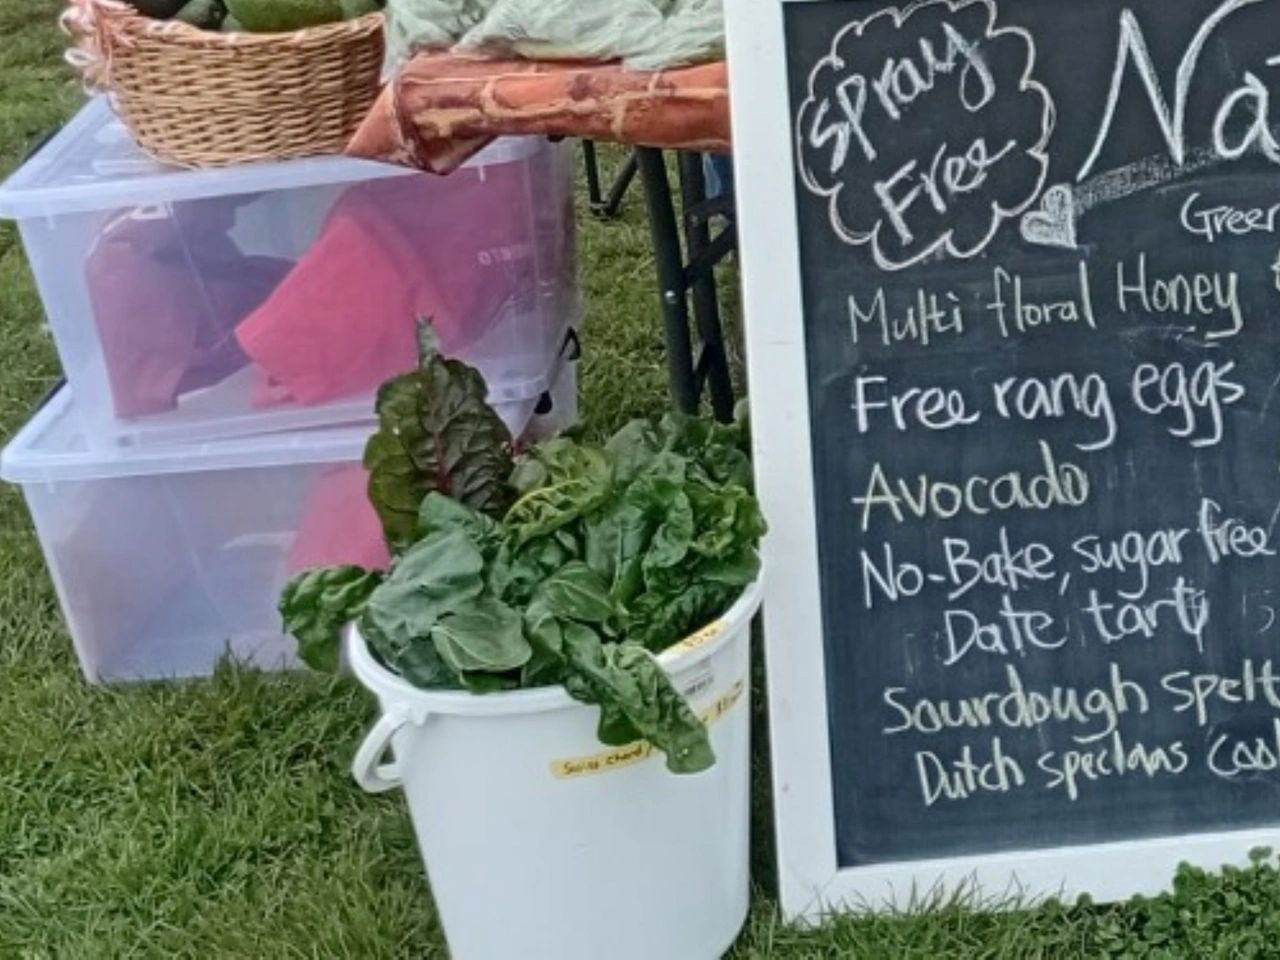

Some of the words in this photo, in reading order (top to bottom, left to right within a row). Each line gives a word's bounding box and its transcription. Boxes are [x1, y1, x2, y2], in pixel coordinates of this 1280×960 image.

[874, 138, 1017, 246] Free
[846, 285, 965, 346] Multi
[987, 259, 1097, 340] floral
[1115, 251, 1244, 339] Honey
[851, 374, 982, 434] Free
[992, 368, 1118, 452] rang
[1131, 357, 1247, 448] eggs
[851, 440, 1091, 533] Avocado
[1071, 526, 1190, 600] sugar
[1198, 501, 1277, 564] free
[942, 593, 1068, 666] Date
[914, 736, 1026, 806] Dutch
